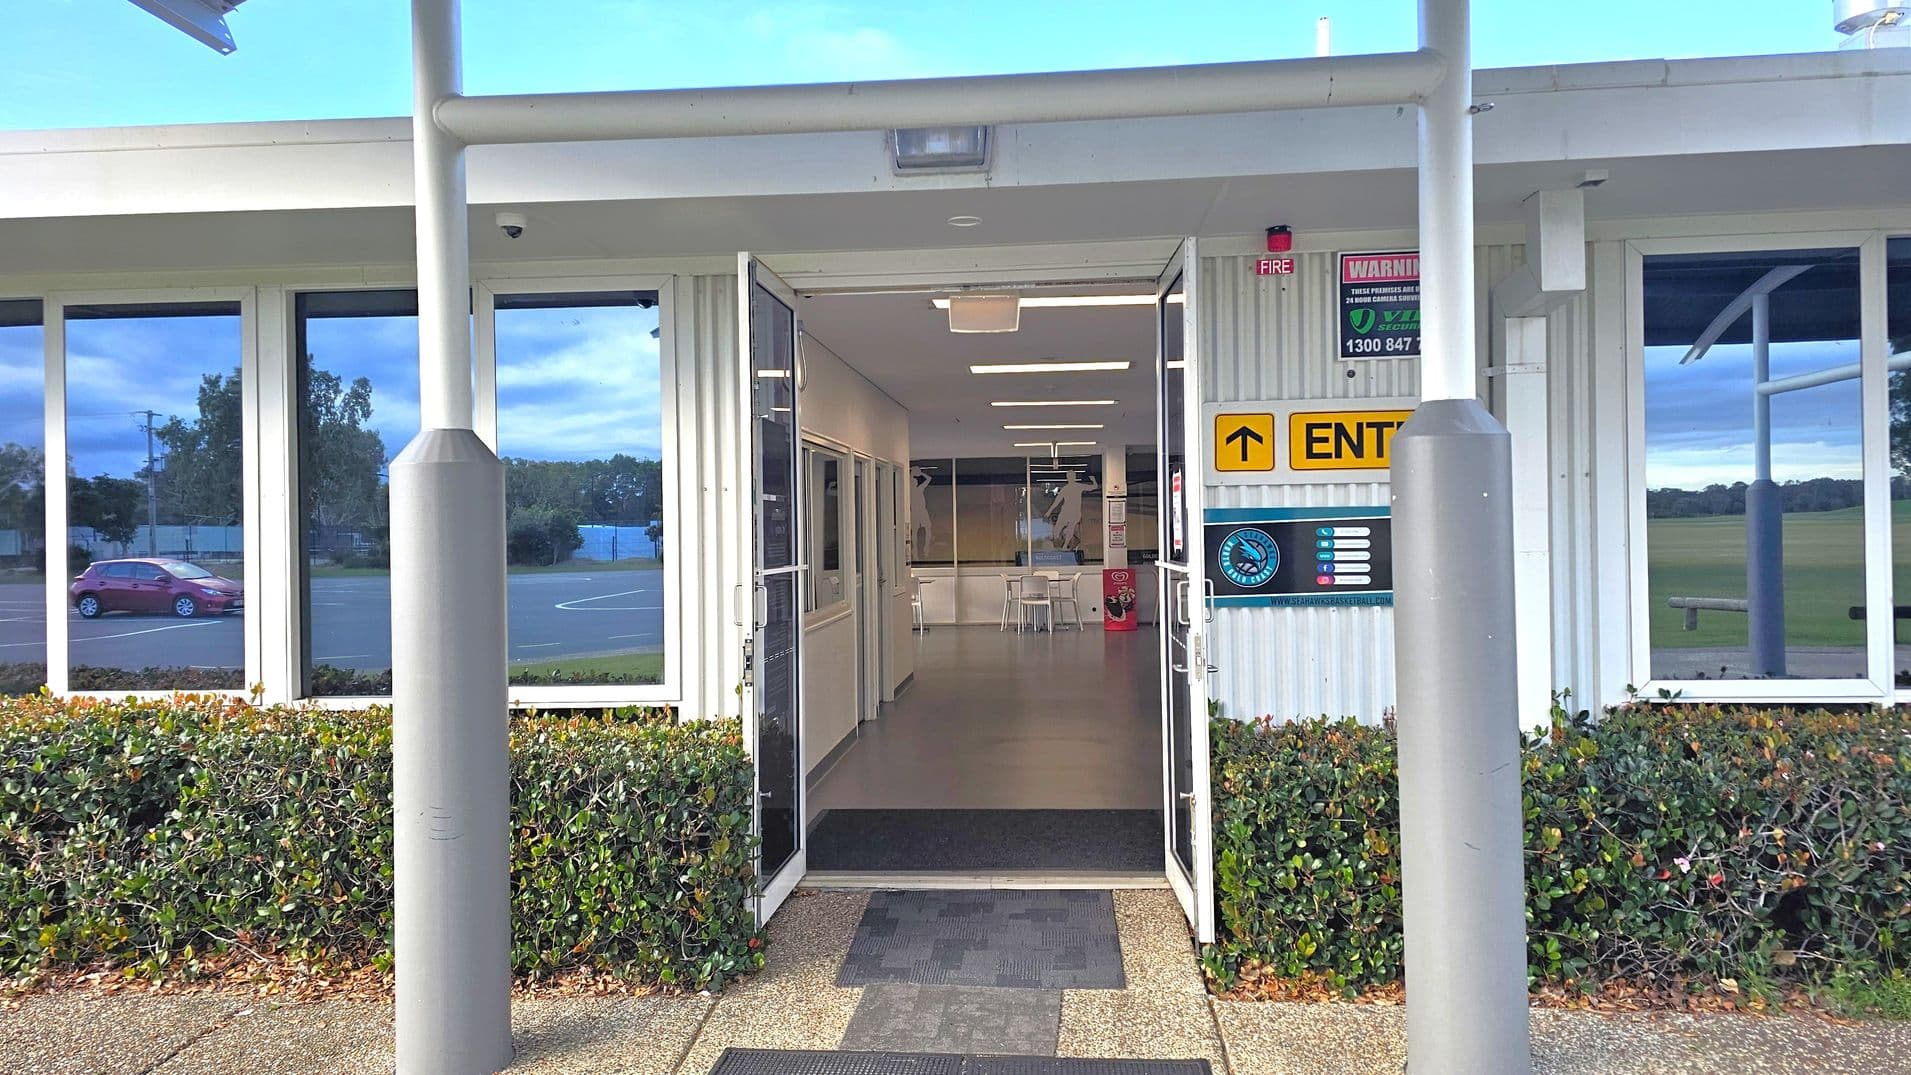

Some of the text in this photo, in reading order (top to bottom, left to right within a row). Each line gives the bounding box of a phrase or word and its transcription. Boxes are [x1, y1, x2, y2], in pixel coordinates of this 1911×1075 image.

[1260, 259, 1291, 274] FIRE
[1349, 258, 1420, 279] WARNIN
[1371, 286, 1401, 294] PREMISES
[1373, 295, 1397, 303] CAMERA
[1377, 322, 1420, 331] SECUR
[1346, 338, 1381, 353] 1300
[1386, 337, 1412, 351] 847
[1305, 421, 1405, 459] ENT
